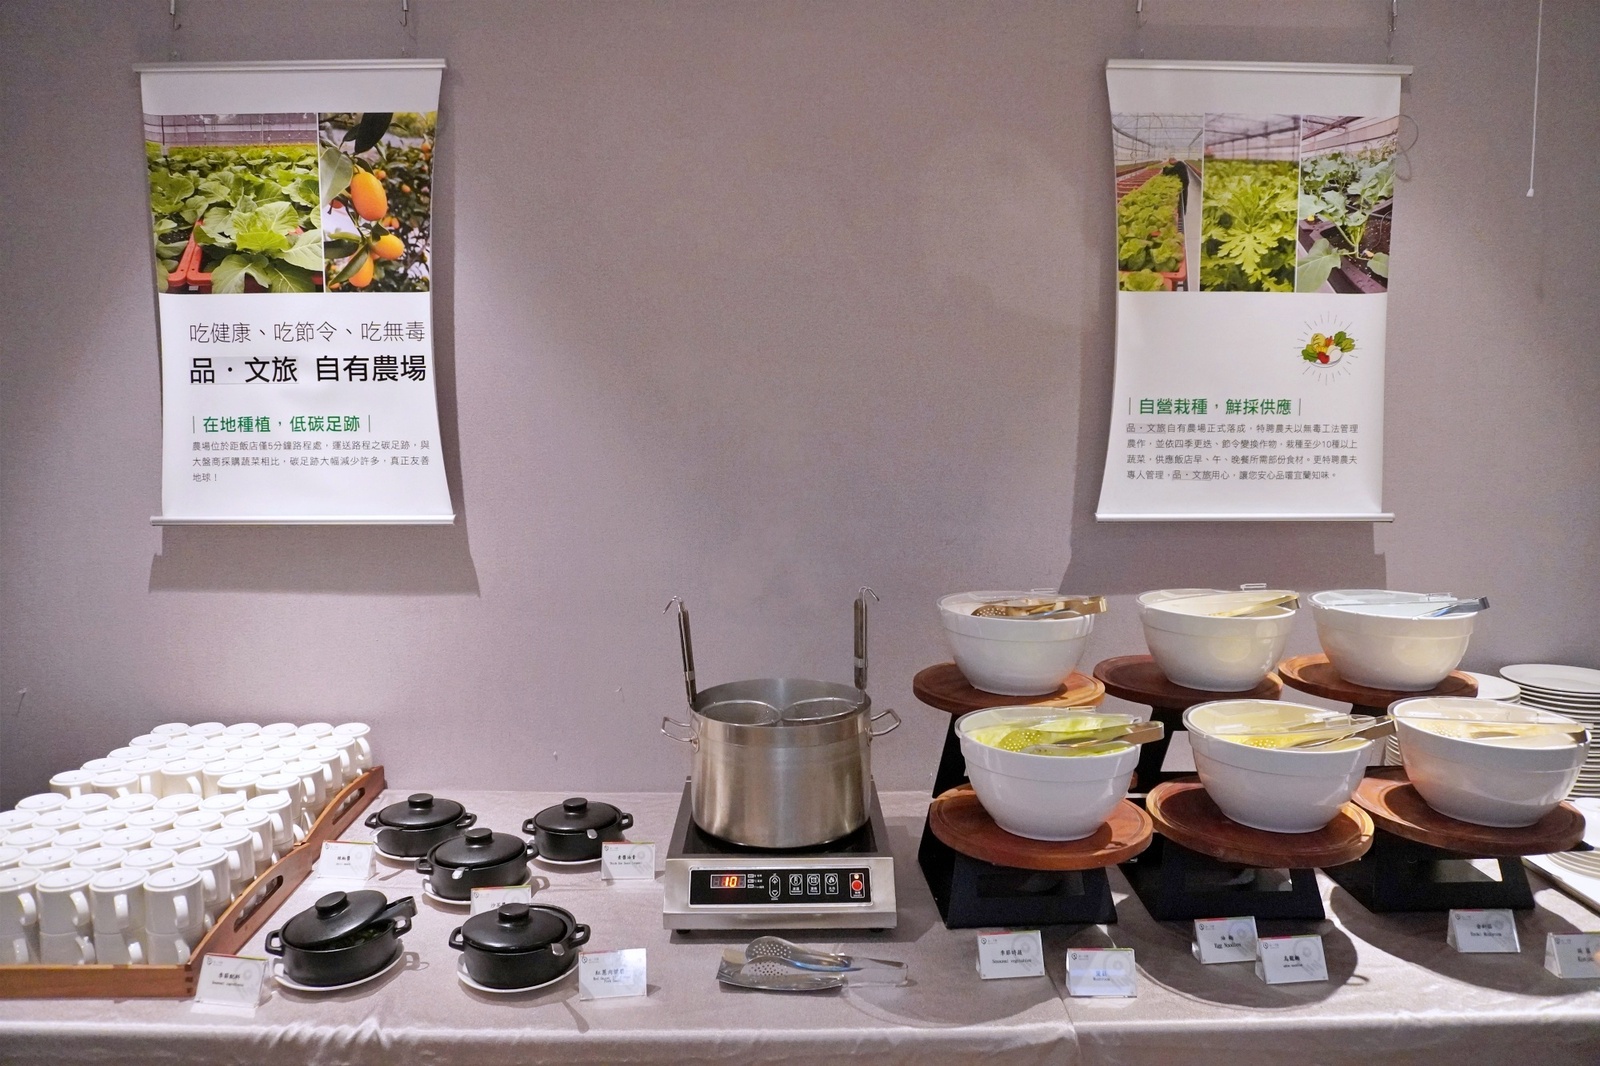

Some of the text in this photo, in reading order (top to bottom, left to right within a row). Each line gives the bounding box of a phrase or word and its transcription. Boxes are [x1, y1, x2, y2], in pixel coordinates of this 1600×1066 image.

[189, 320, 426, 344] 吃健康、吃節令、吃無毒
[316, 354, 427, 383] 自有農場
[1139, 397, 1293, 416] 自營栽種，鮮採供應
[203, 415, 361, 433] 在地種植，低碳足跡
[192, 472, 217, 483] 地球！
[725, 876, 738, 888] 10
